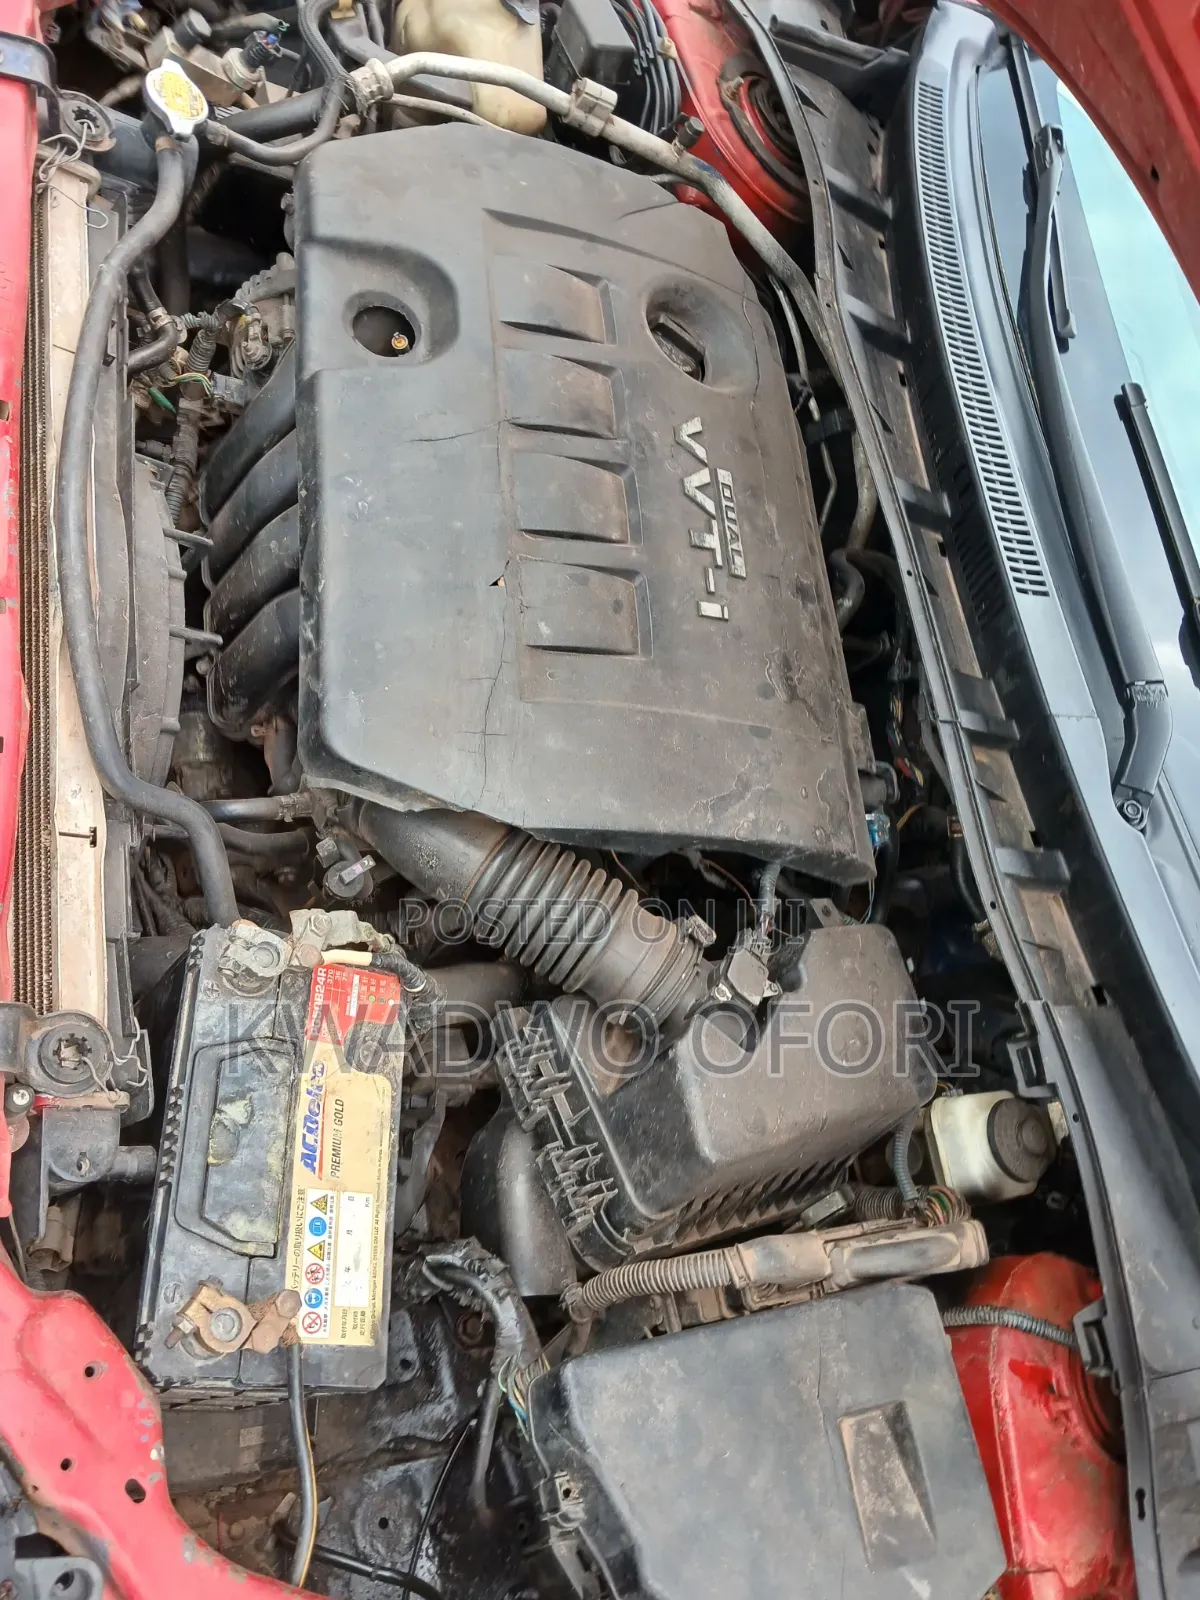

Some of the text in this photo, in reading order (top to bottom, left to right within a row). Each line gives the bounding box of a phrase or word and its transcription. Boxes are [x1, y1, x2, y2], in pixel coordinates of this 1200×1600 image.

[672, 416, 729, 621] VVT-i
[720, 481, 744, 566] DUAL
[326, 969, 334, 984] 370
[330, 1098, 344, 1178] PREMIUM GOLD
[364, 1197, 370, 1208] Km
